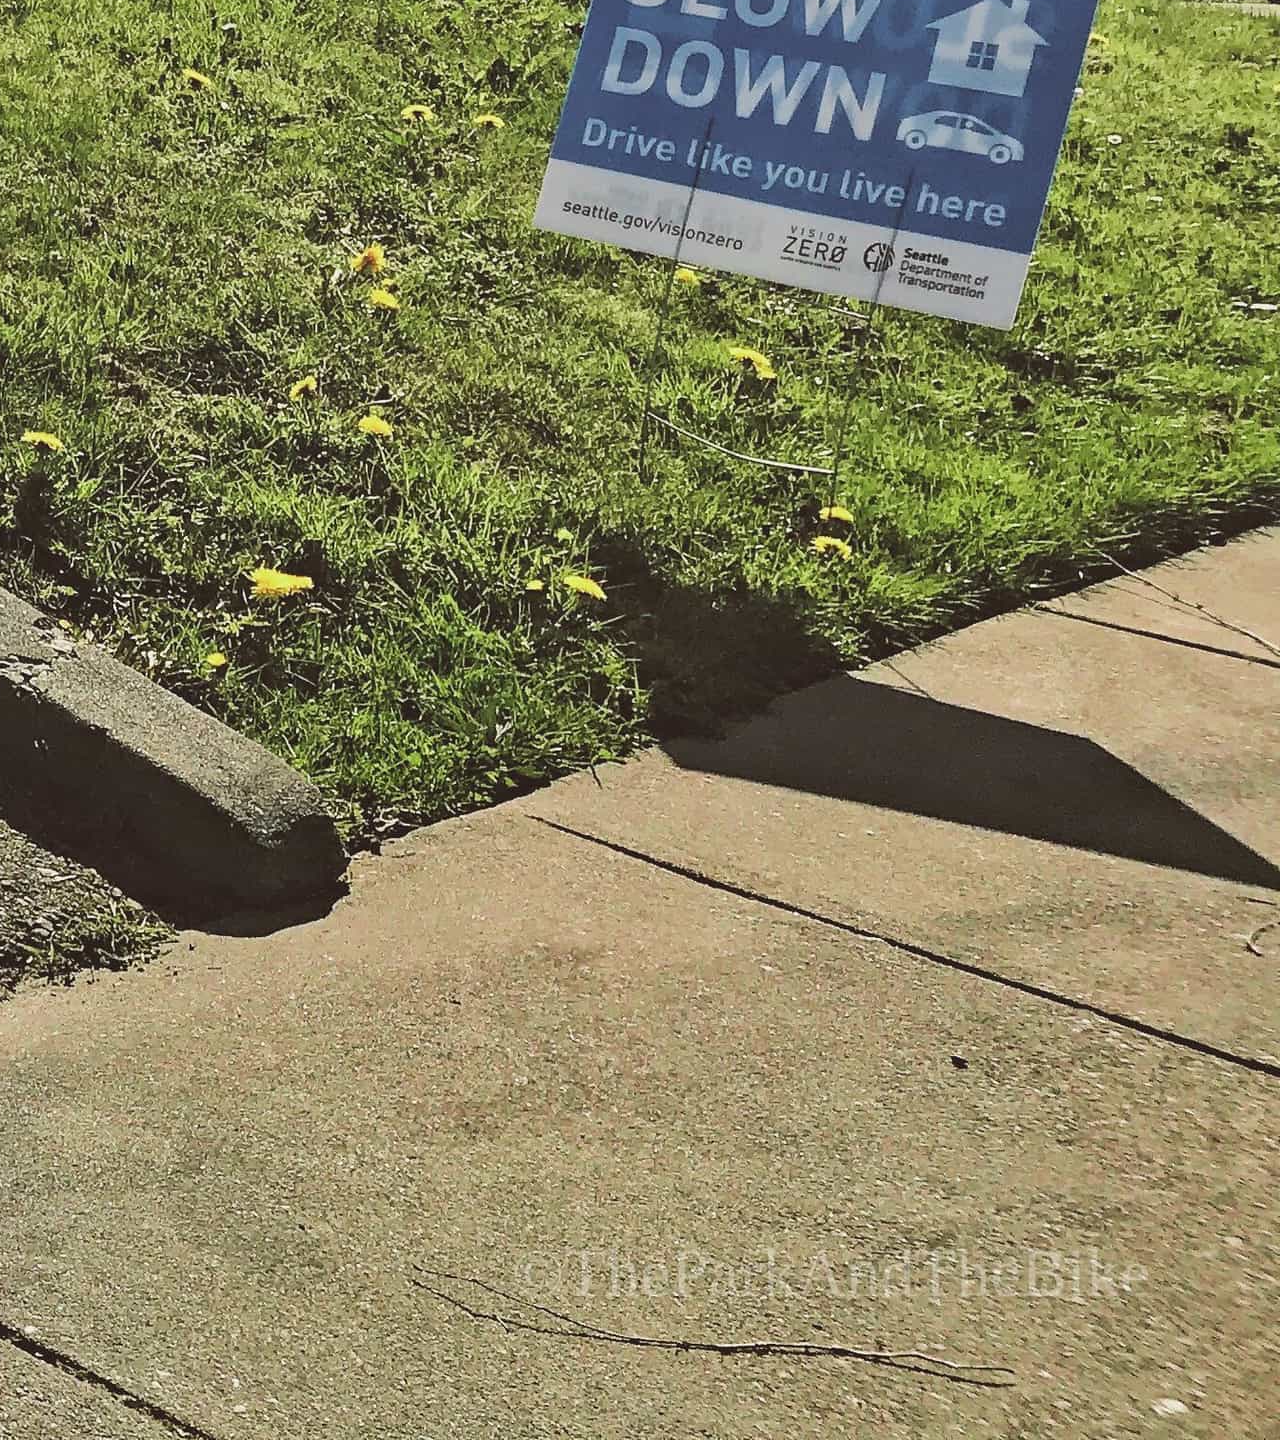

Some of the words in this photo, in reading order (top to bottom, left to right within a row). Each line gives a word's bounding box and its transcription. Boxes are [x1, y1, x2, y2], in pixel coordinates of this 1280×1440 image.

[600, 26, 887, 142] DOWN
[581, 117, 674, 162] Drive
[685, 138, 753, 179] like
[759, 162, 828, 194] you
[840, 169, 906, 208] live
[915, 184, 1006, 227] here
[562, 199, 744, 251] seattle.gov/visionzero
[790, 224, 848, 244] VISION
[904, 247, 949, 266] Seattle
[898, 273, 985, 300] Transportation
[900, 260, 972, 286] Department
[973, 276, 989, 291] of
